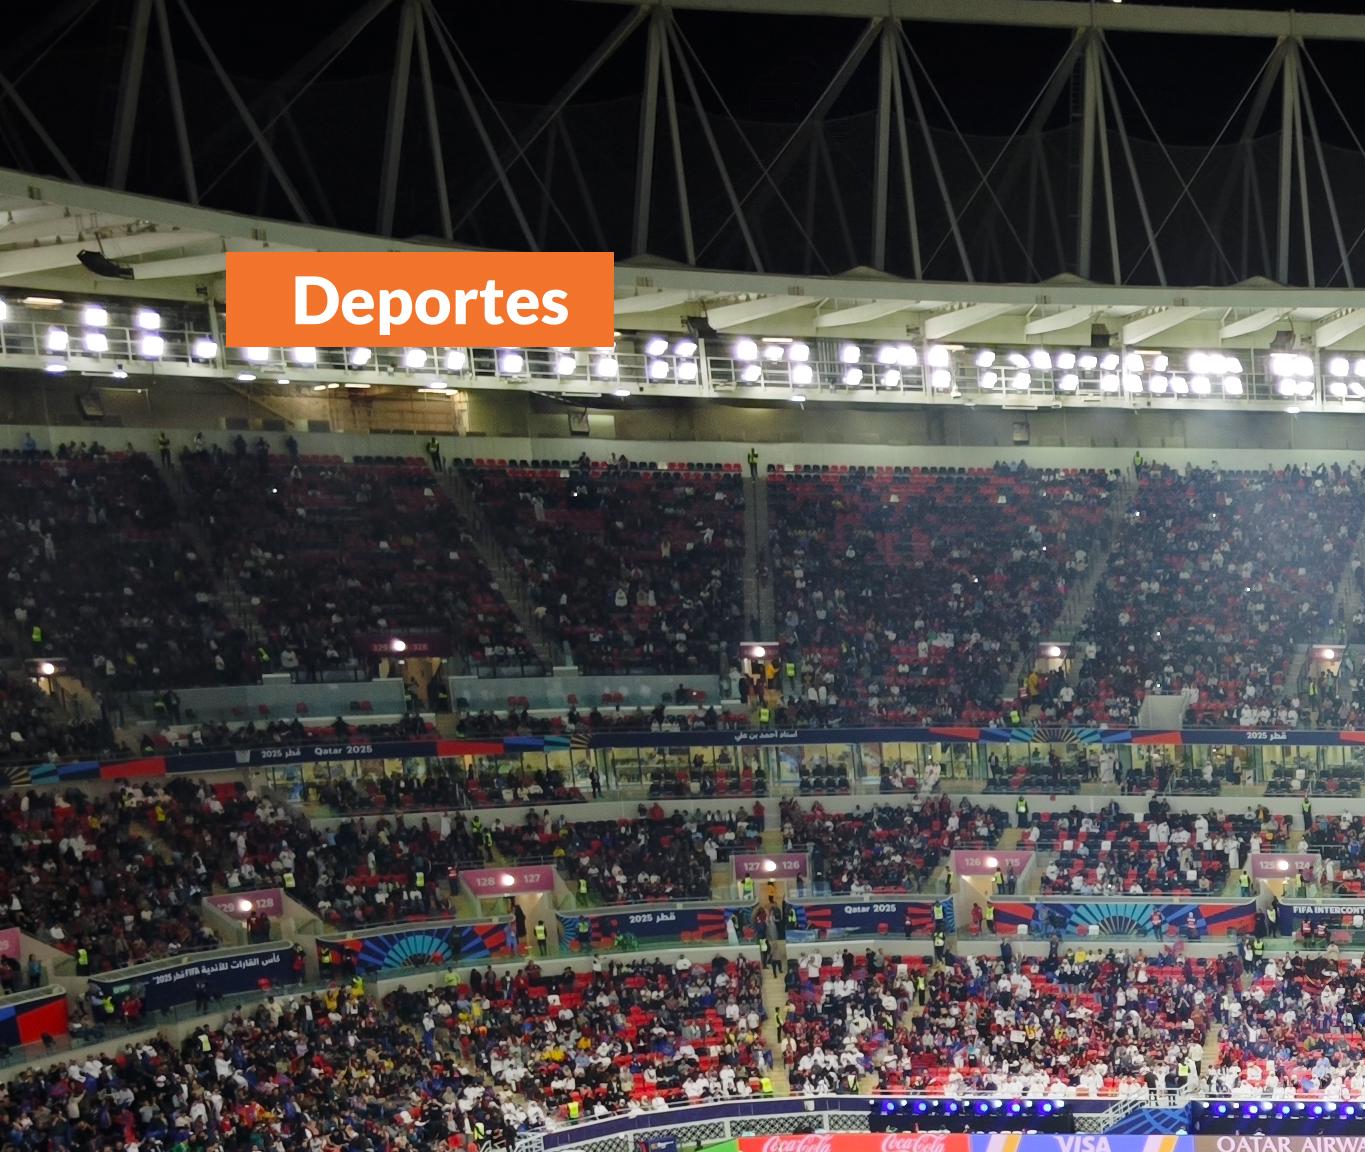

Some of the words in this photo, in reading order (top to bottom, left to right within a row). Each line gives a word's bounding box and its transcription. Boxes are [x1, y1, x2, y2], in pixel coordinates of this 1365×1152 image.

[1247, 731, 1268, 740] 2025
[262, 750, 283, 758] 2025
[314, 747, 343, 756] Qatar
[346, 745, 373, 755] 2025
[475, 876, 497, 887] 128
[523, 874, 543, 884] 127
[255, 899, 275, 911] 128
[844, 904, 871, 914] Qatar
[872, 903, 897, 913] 2025
[1293, 906, 1313, 915] FIFA
[629, 912, 653, 923] 2025
[656, 912, 676, 923] قطر
